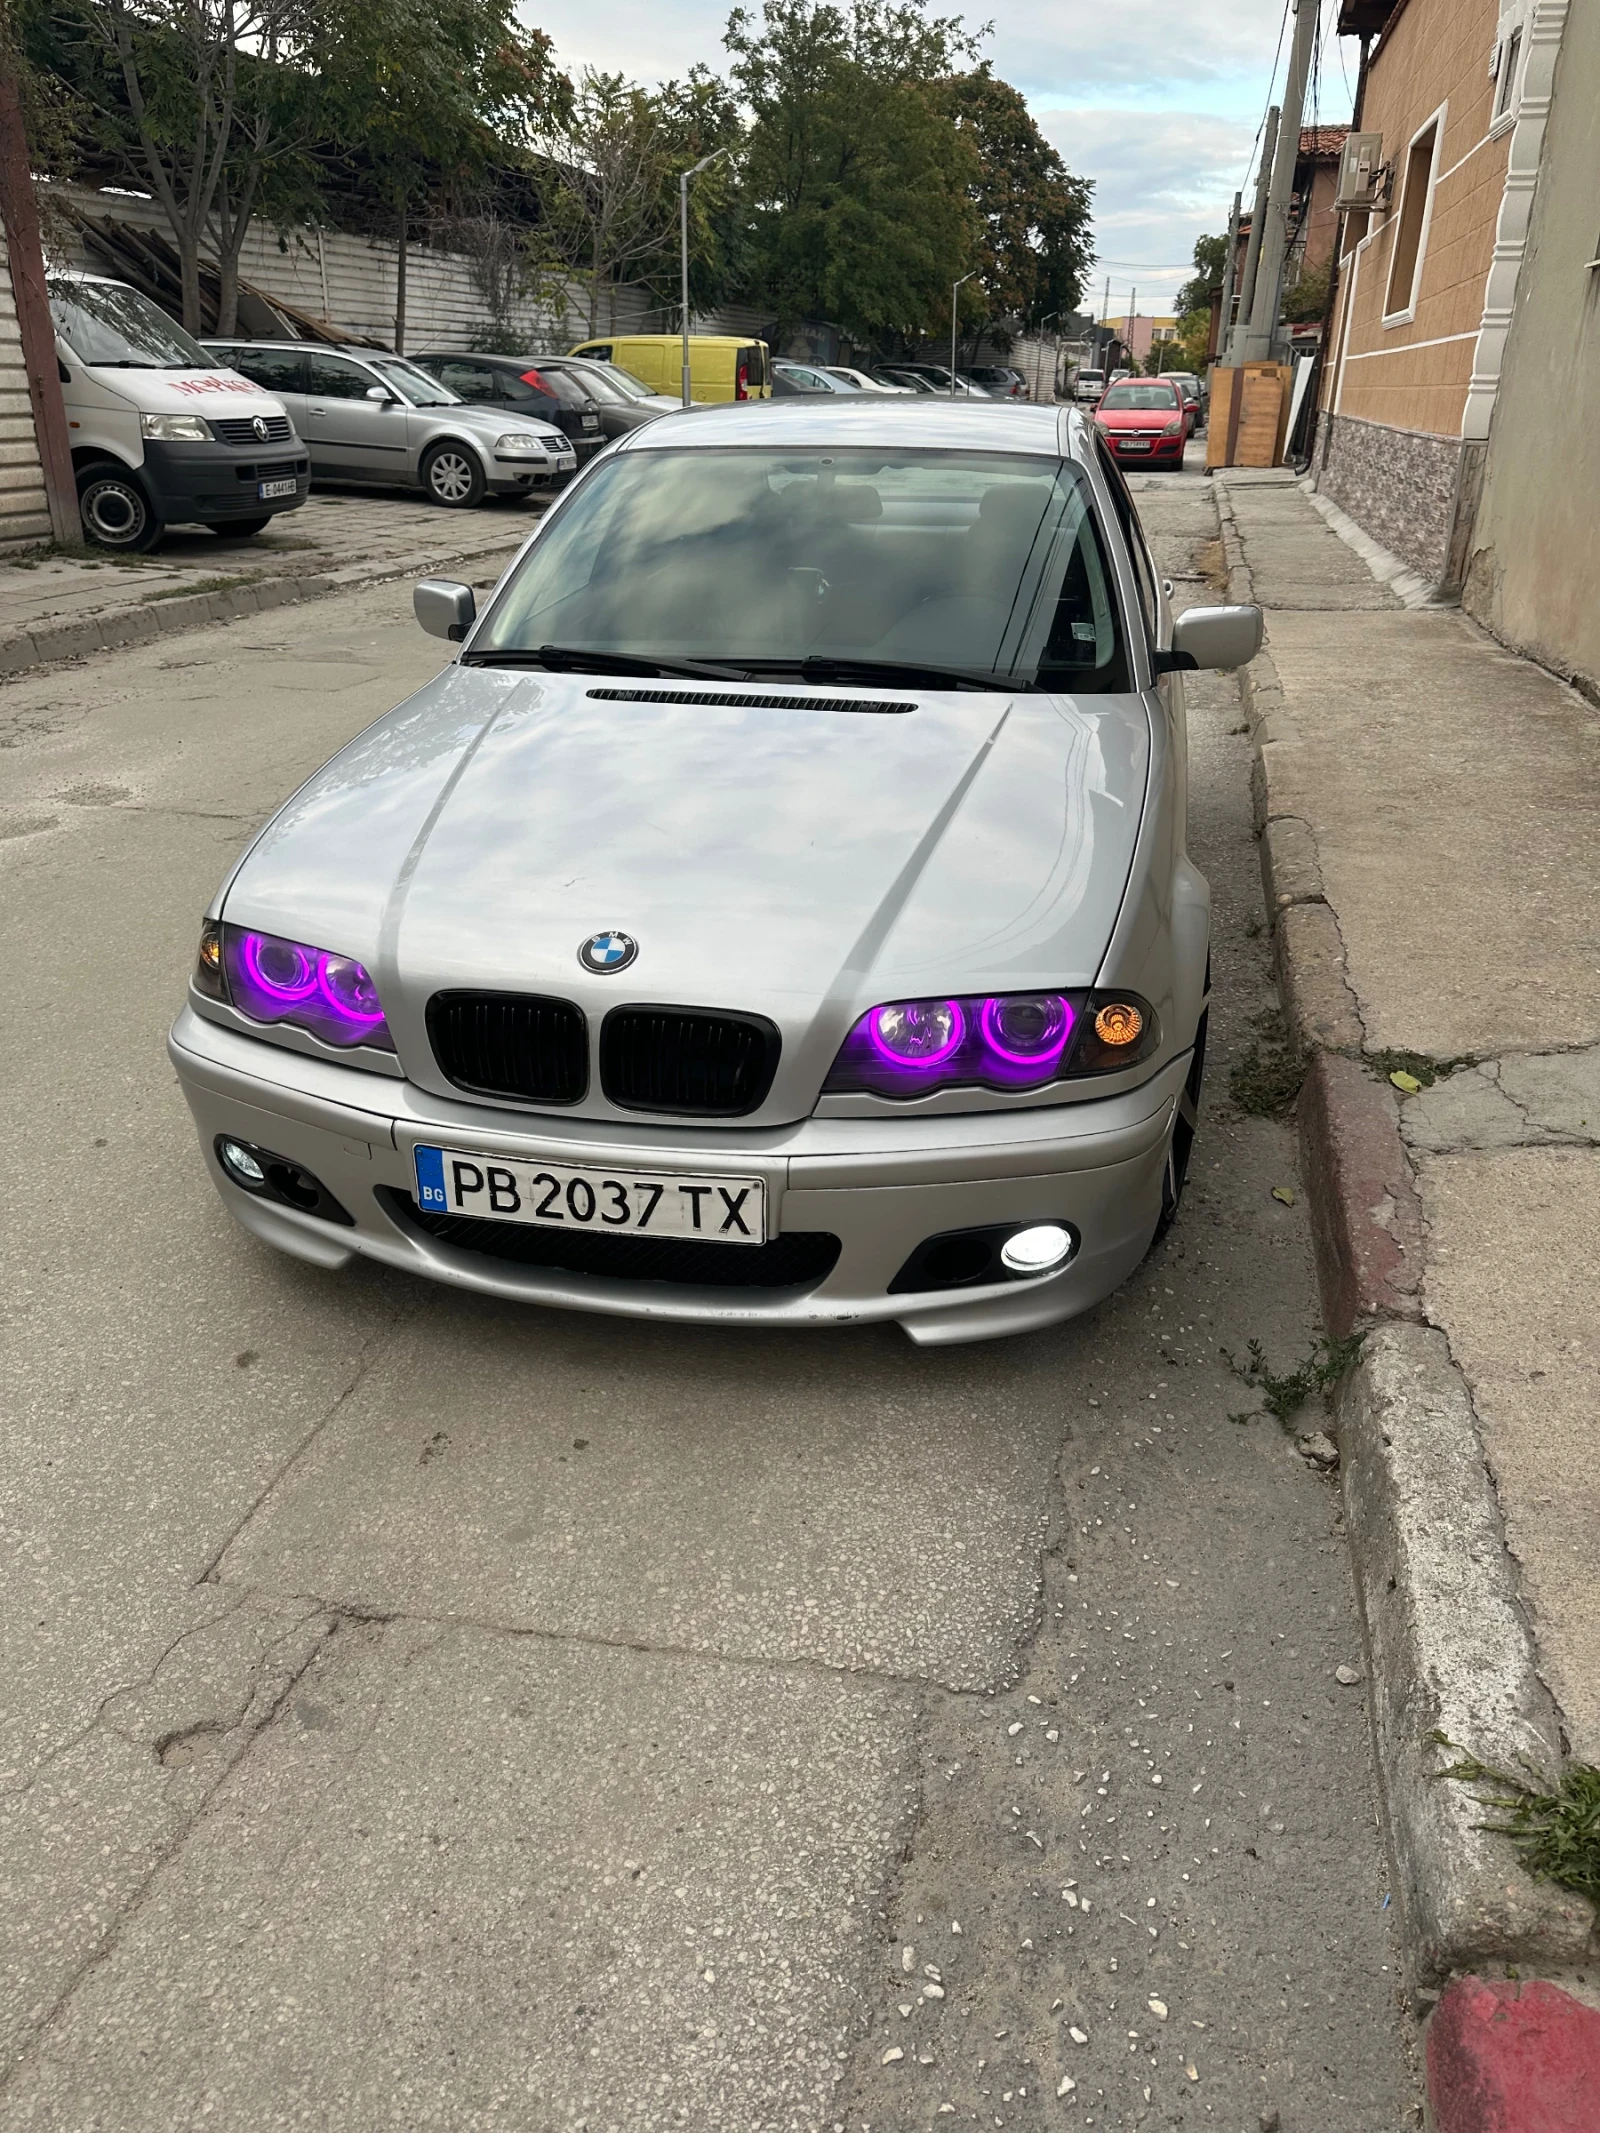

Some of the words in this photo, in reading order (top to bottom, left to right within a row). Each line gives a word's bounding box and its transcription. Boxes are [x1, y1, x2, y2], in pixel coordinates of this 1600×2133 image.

[591, 930, 632, 945] BMW
[423, 1186, 444, 1202] BG
[452, 1160, 521, 1214] PB
[532, 1172, 664, 1229] 2037
[678, 1185, 751, 1236] TX
